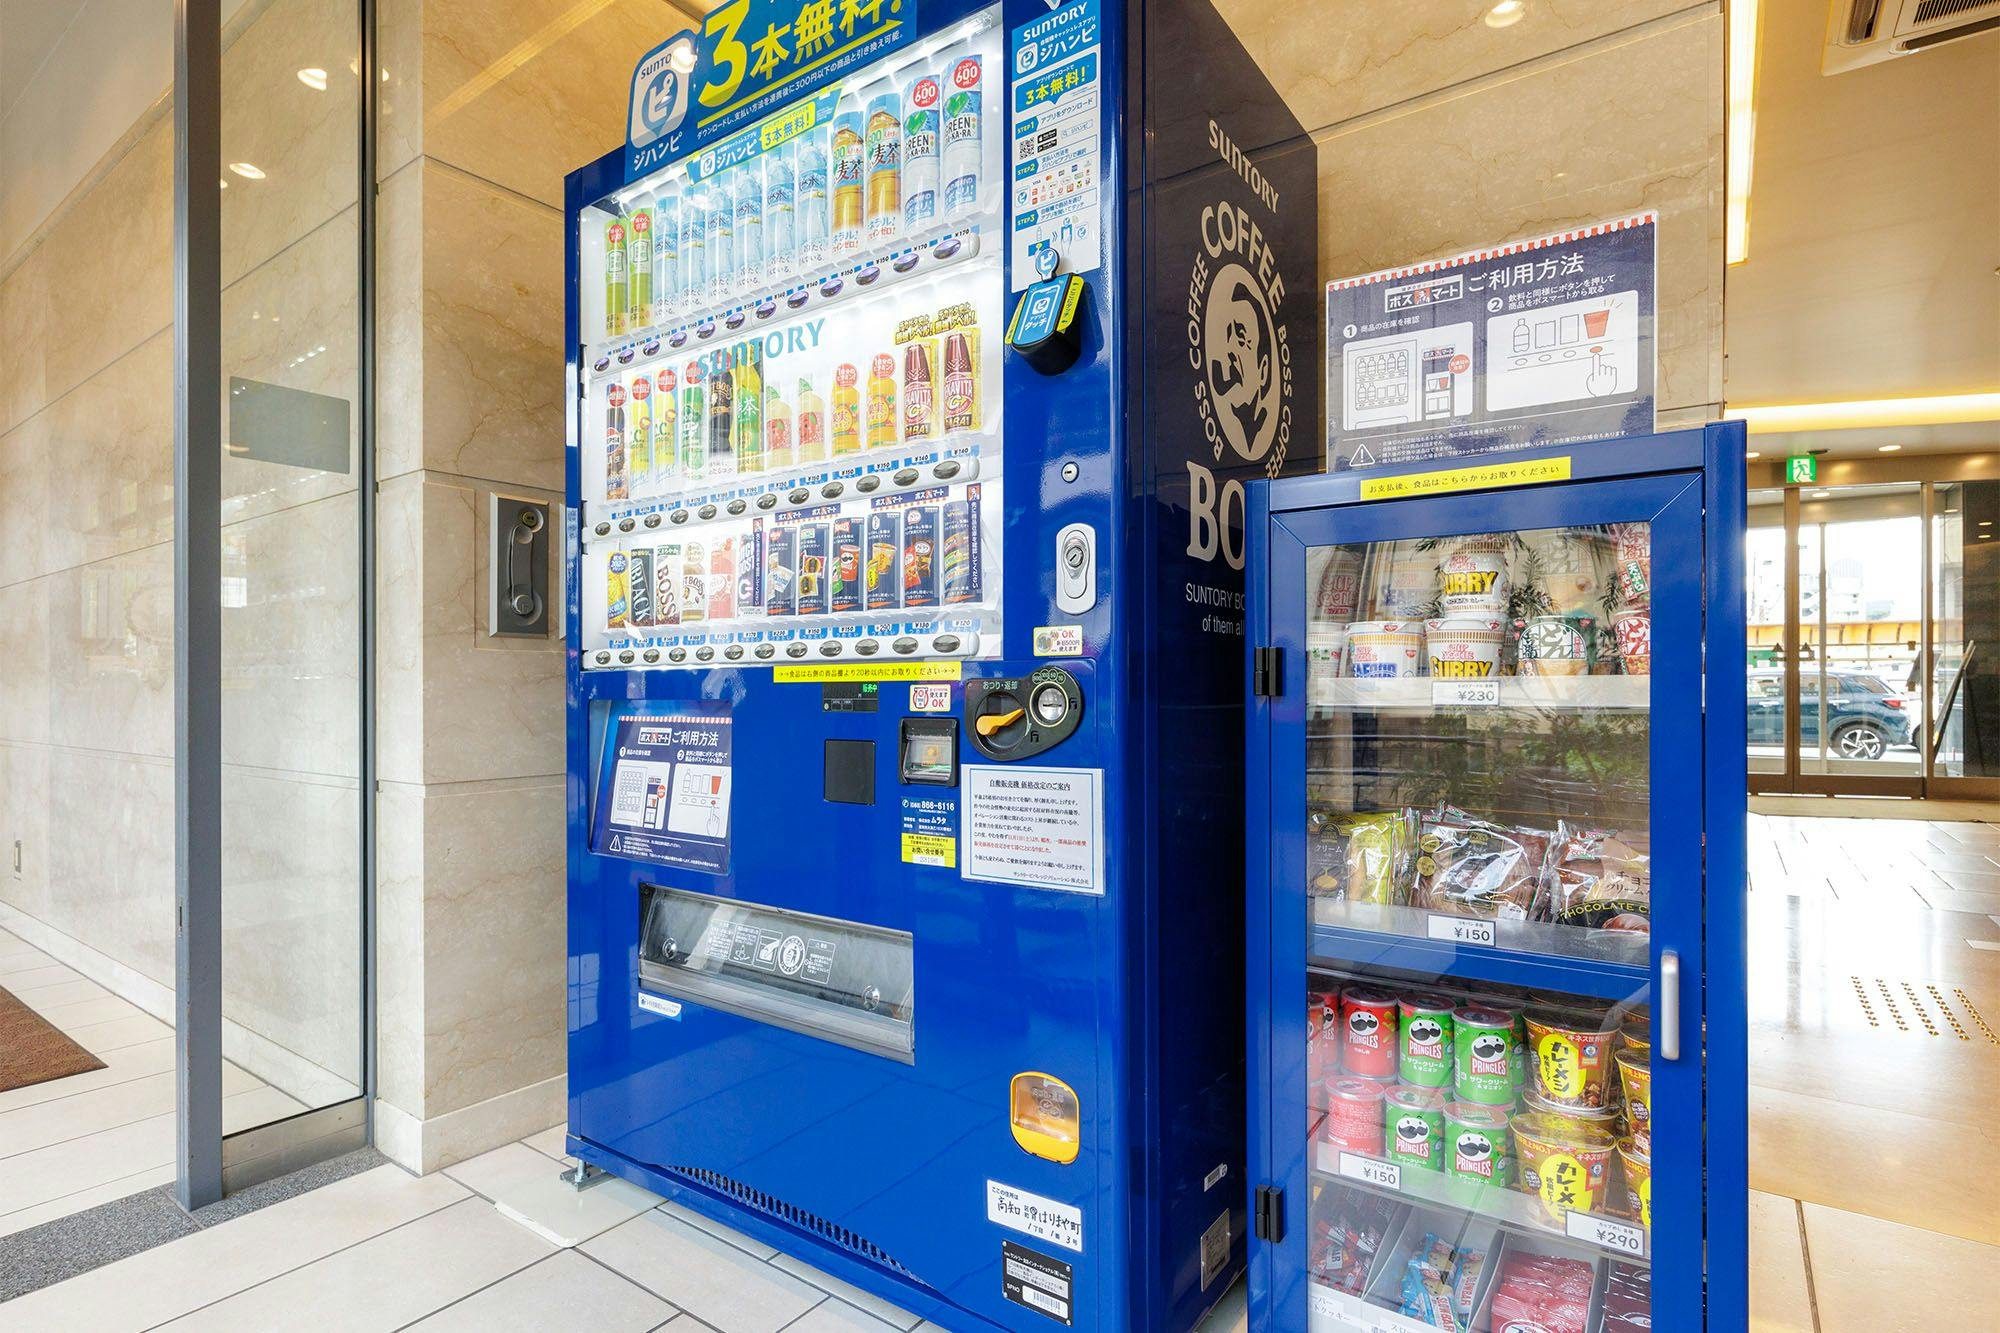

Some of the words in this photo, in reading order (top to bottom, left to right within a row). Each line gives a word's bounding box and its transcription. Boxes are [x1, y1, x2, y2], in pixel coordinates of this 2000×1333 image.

[1023, 2, 1088, 42] SUNTORY
[1041, 24, 1097, 62] ジハンピ
[956, 68, 978, 83] 600
[915, 87, 936, 103] 600
[633, 131, 684, 172] ジハンピ
[716, 139, 758, 168] ジハンピ
[873, 143, 901, 168] 麦茶
[836, 160, 863, 185] 麦茶
[1208, 119, 1279, 214] SUNTORY
[955, 229, 970, 238] ¥170
[914, 243, 928, 252] ¥170
[1201, 201, 1285, 314] COFFEE
[1468, 253, 1584, 293] ご利用方法
[1508, 274, 1615, 303] 飲料と同様にボタンを押して
[1508, 285, 1605, 311] 商品をボスマートから取る
[1187, 252, 1209, 370] COFFEE
[1360, 315, 1420, 333] 商品の在庫を確認
[695, 317, 826, 382] SUNTORY
[1278, 324, 1292, 397] BOSS
[1195, 380, 1224, 462] BOSS
[1265, 407, 1292, 480] COFFEE
[1369, 466, 1560, 494] お支払後、食品はこちらからお取りください
[1186, 461, 1245, 570] BO
[657, 564, 677, 617] BOSS
[1186, 583, 1233, 607] SUNTORY
[1062, 630, 1074, 639] OK
[1202, 617, 1212, 631] of
[1213, 617, 1234, 635] them
[932, 699, 944, 708] OK
[1458, 690, 1495, 701] ¥230
[672, 730, 719, 747] ご利用方法
[1315, 845, 1342, 853] クリーム
[1454, 927, 1490, 942] ¥150
[1350, 1030, 1379, 1049] PRINGLES
[1409, 1042, 1442, 1060] PRINGLES
[1407, 1057, 1445, 1069] サワークリーム
[1471, 1057, 1506, 1076] PRINGLES
[1551, 1041, 1569, 1092] カレーメシ
[1396, 1138, 1429, 1158] PRINGLES
[1363, 1168, 1396, 1185] ¥150
[1456, 1154, 1492, 1177] PRINGLES
[992, 1187, 1019, 1200] ここの住所は
[998, 1196, 1021, 1216] 高知
[1039, 1211, 1081, 1235] はりまや町
[1596, 1229, 1640, 1250] ¥290
